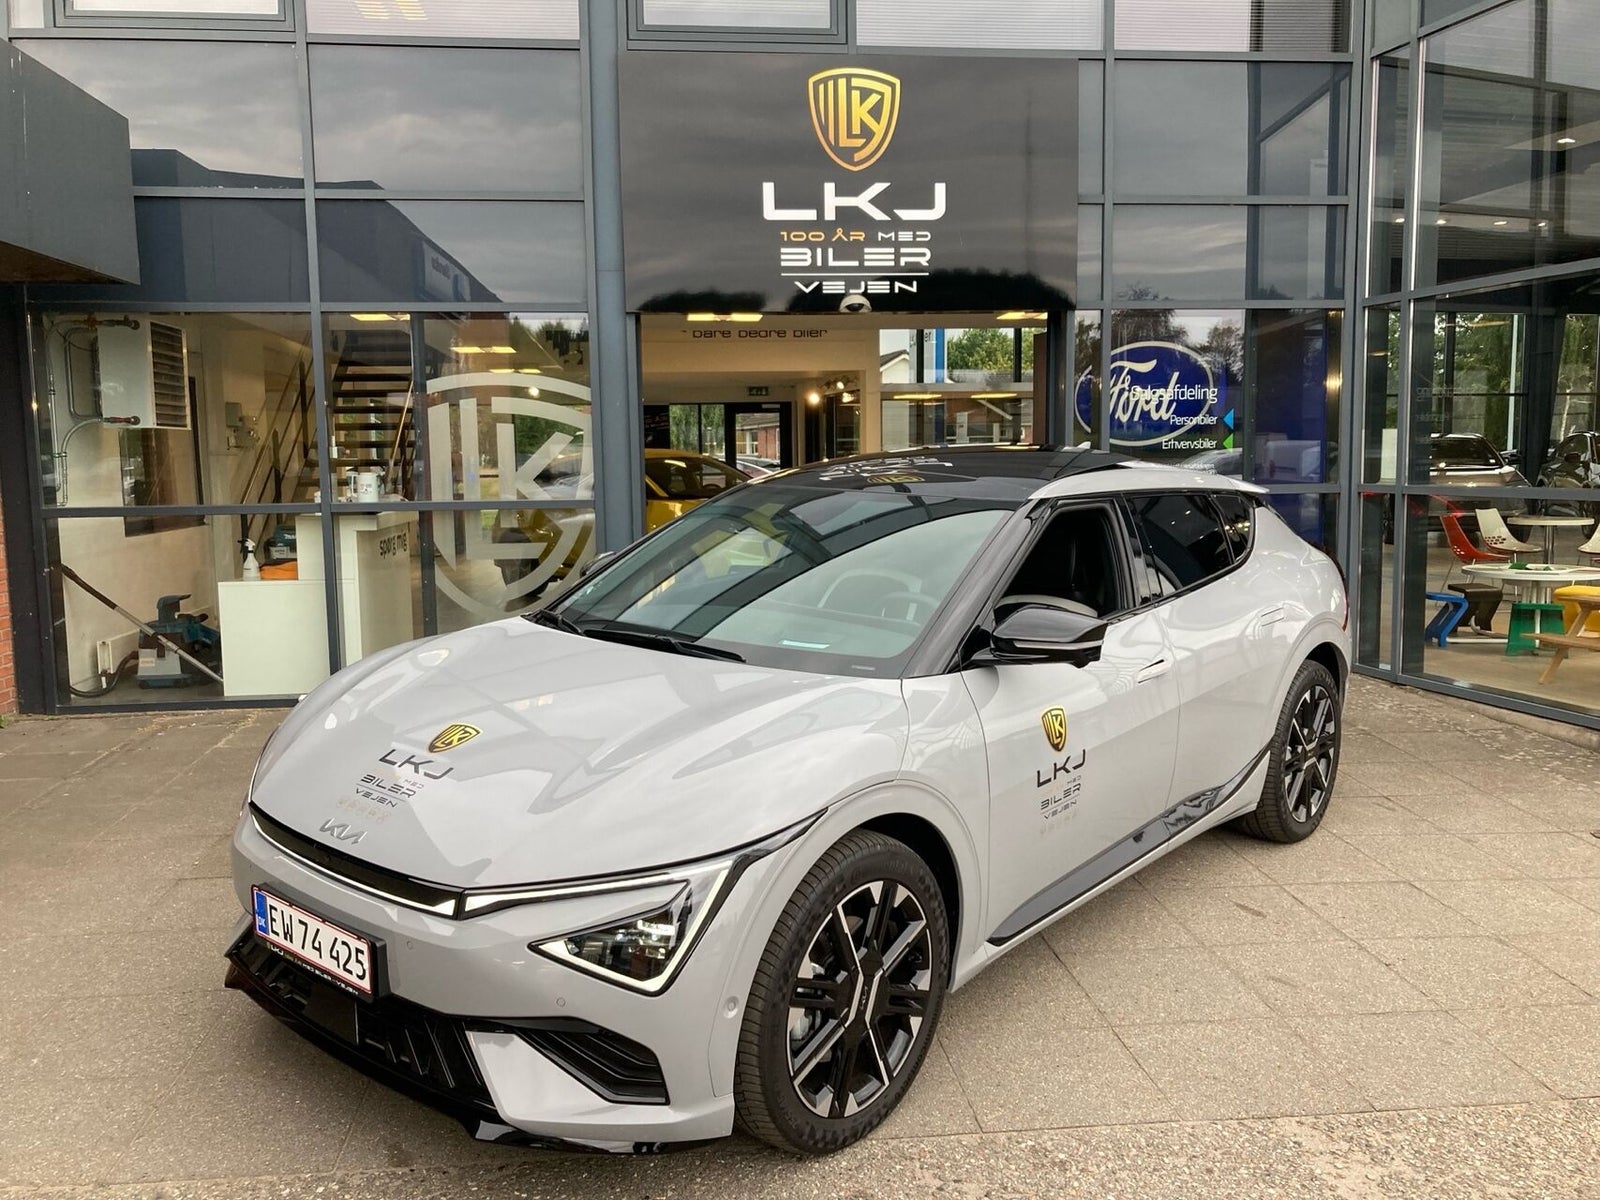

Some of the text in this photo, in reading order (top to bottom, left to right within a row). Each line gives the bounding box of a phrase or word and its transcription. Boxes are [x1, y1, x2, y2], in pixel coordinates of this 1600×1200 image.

[762, 181, 947, 221] LKJ
[780, 227, 931, 242] 100 ÅR MED
[780, 247, 931, 266] BILER
[794, 280, 917, 294] VEJEN
[1169, 414, 1217, 425] Personbiler
[1162, 438, 1217, 449] Erhvervsbiler
[379, 749, 454, 779] LKJ
[1037, 749, 1086, 788] LKJ
[360, 774, 417, 798] BILER
[1040, 783, 1082, 810] BILER
[355, 787, 398, 808] VEJEN
[298, 918, 323, 960] 74
[329, 937, 367, 980] 425
